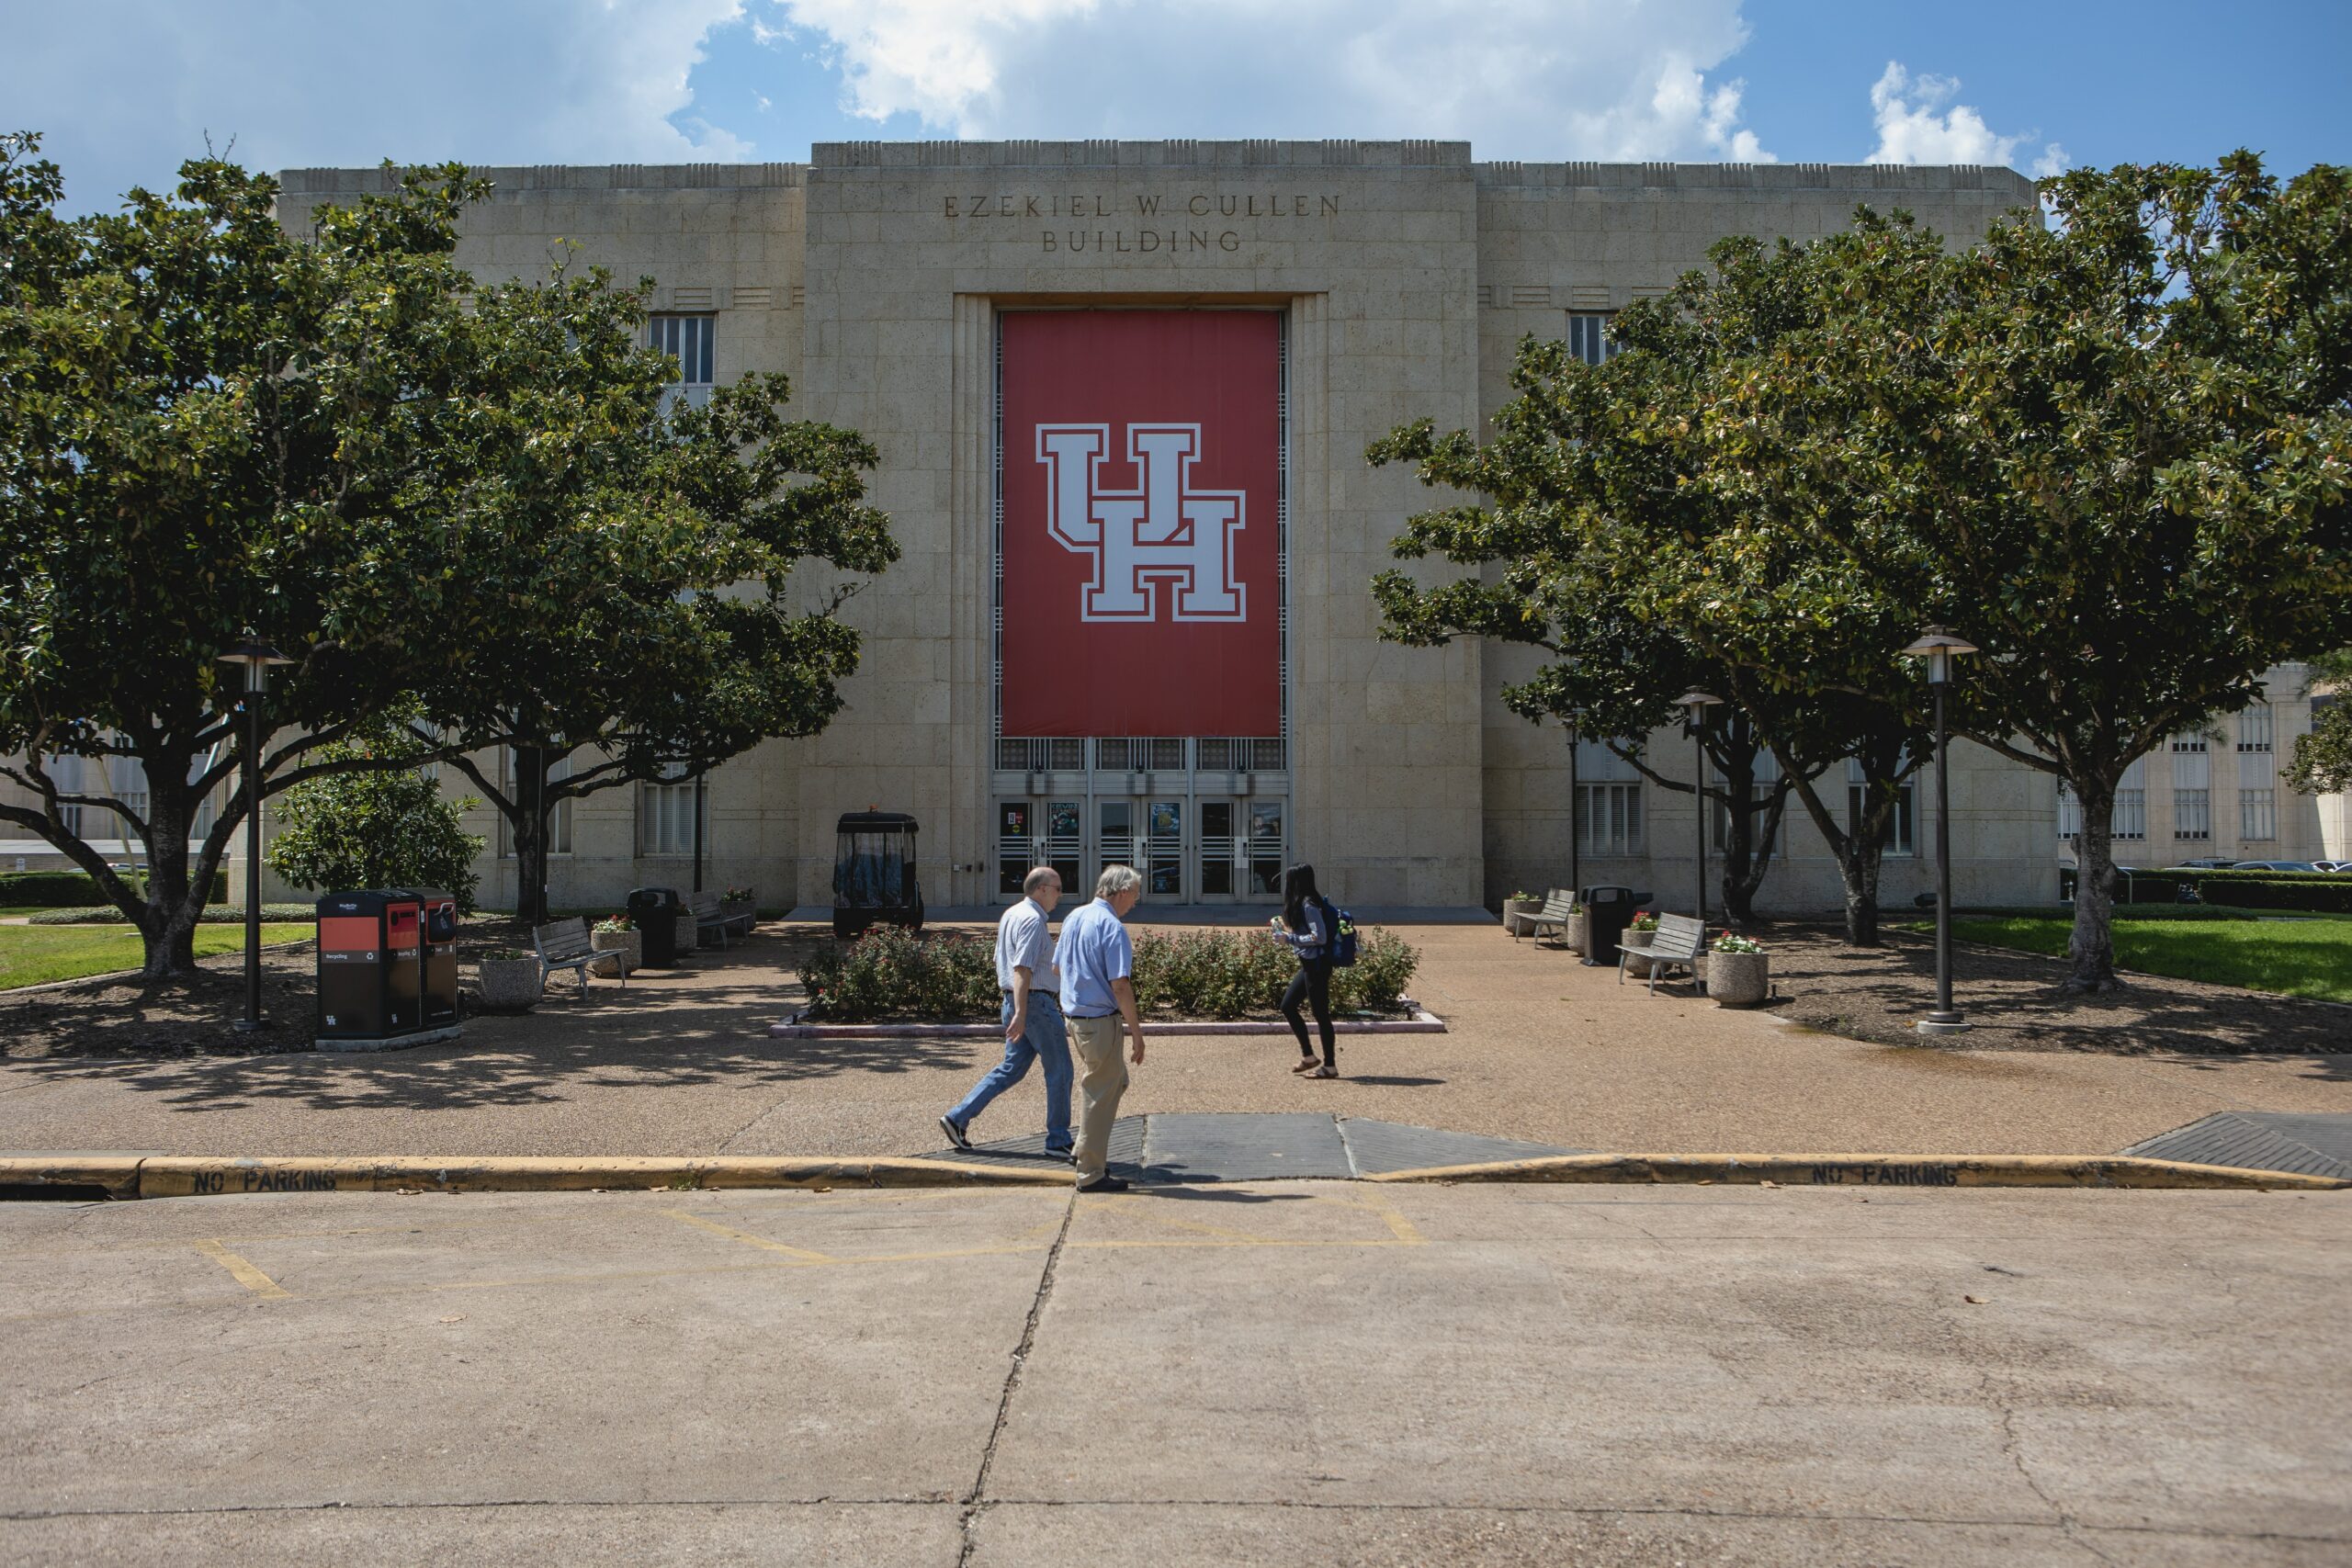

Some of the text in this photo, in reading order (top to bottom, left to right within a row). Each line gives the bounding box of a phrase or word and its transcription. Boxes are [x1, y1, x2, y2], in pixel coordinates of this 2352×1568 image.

[944, 196, 1112, 218] EZEKIEL
[1188, 196, 1340, 217] CULLEN
[1042, 231, 1241, 253] BUILDING
[1035, 423, 1247, 623] UH
[193, 1169, 336, 1192] NO PARKING
[1812, 1164, 1957, 1185] NO PARKING
